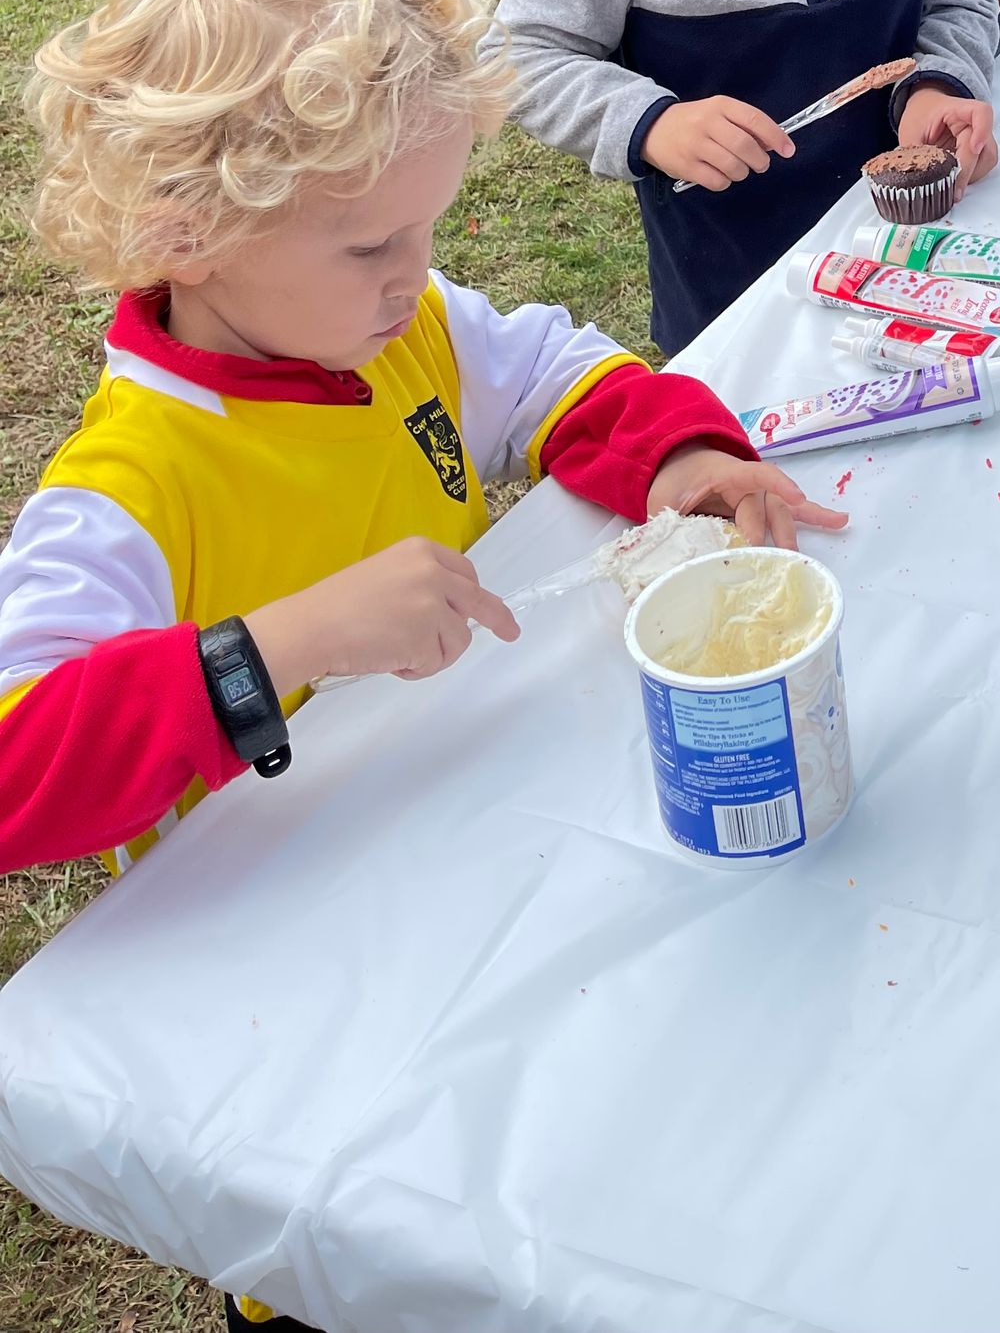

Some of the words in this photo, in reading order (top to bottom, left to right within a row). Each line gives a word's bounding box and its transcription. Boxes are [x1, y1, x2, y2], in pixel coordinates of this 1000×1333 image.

[697, 696, 717, 707] Easy
[719, 696, 731, 705] To
[734, 695, 750, 704] Use
[694, 736, 767, 750] PillsburyBaking.com
[713, 755, 735, 764] GLUTEN
[735, 753, 750, 762] FREE
